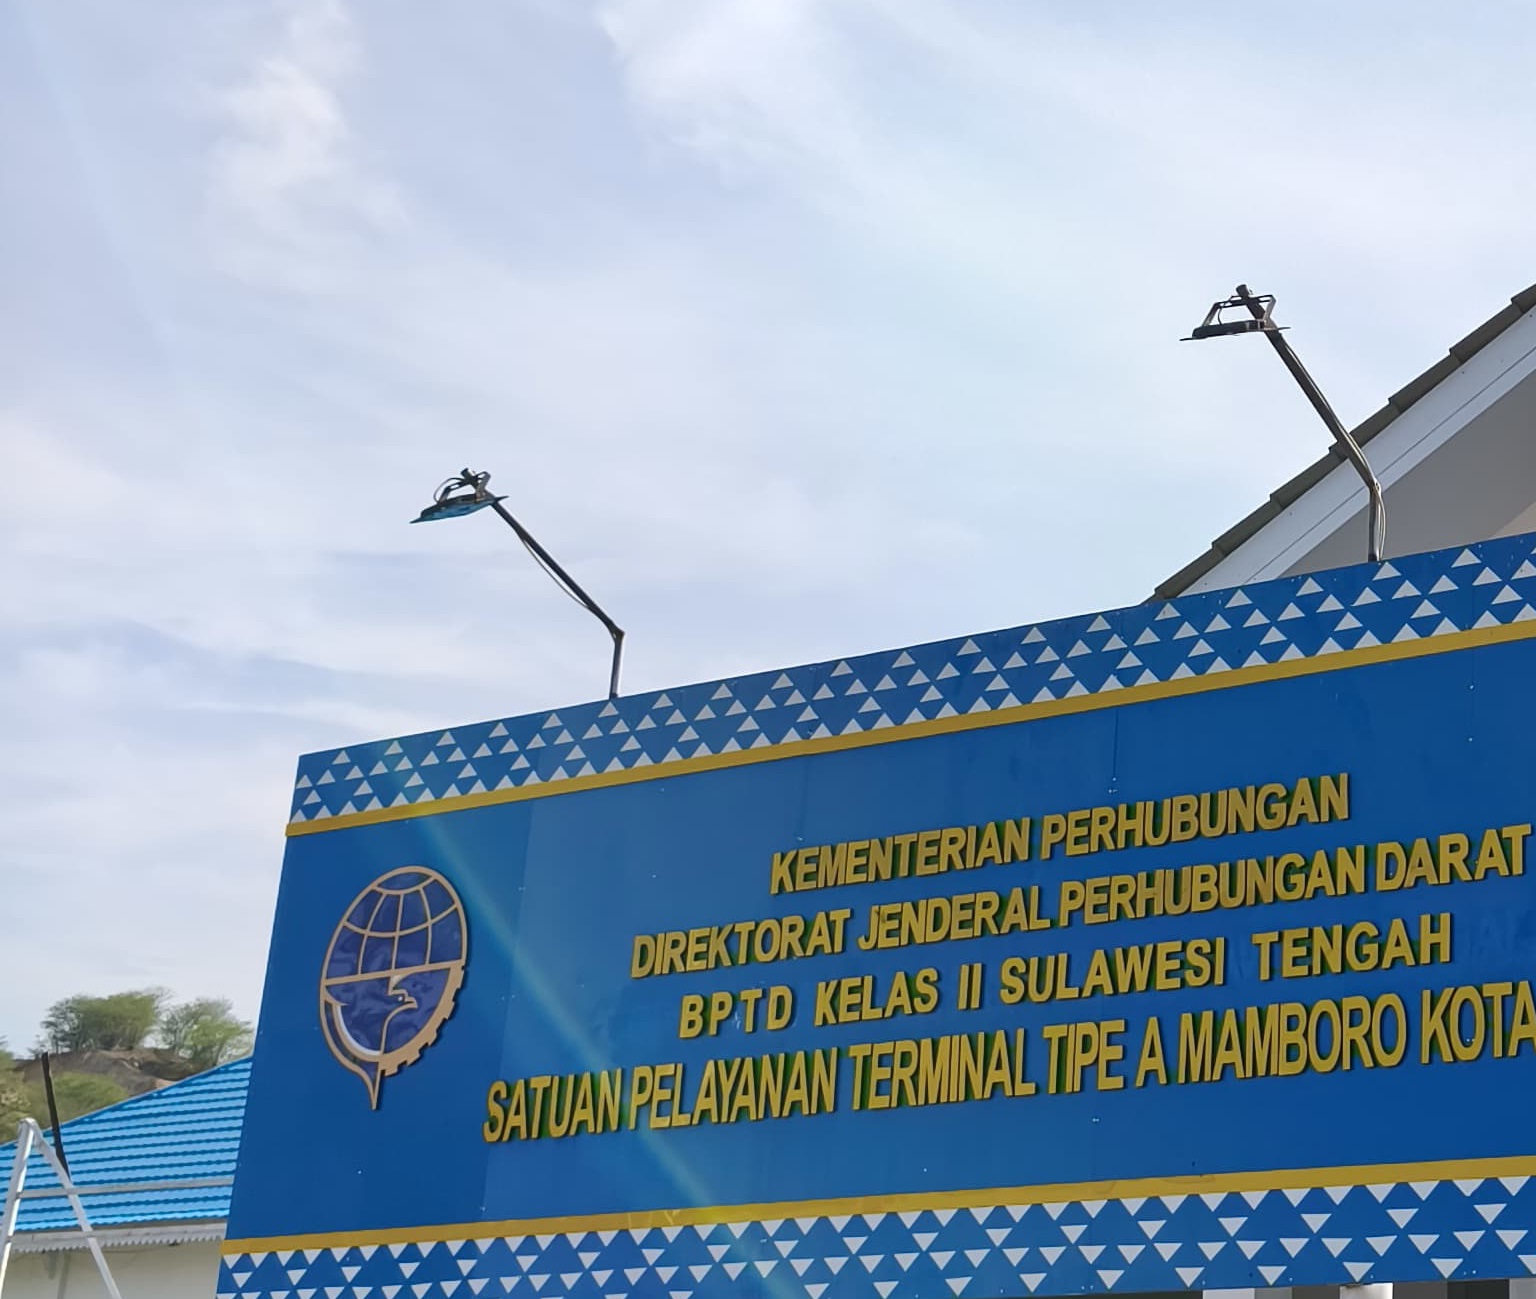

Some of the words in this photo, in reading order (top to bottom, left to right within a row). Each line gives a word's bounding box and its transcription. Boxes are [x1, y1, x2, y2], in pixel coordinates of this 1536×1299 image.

[631, 910, 850, 978] DIREKTORAT
[858, 887, 1051, 950] JENDERAL
[1057, 846, 1365, 927] PERHUBUNGAN
[1375, 825, 1530, 891] DARAT
[771, 819, 1031, 894] KEMENTERIAN
[1040, 775, 1347, 859] PERHUBUNGAN
[679, 986, 792, 1038] BPTD
[814, 969, 937, 1026] KELAS
[958, 964, 981, 1009] II
[1000, 938, 1224, 1004] SULAWESI
[1252, 914, 1450, 980] TENGAH
[483, 1070, 621, 1140] SATUAN
[628, 1049, 838, 1129] PELAYANAN
[847, 1030, 1036, 1110] TERMINAL
[1043, 1020, 1124, 1094] TIPE
[1136, 1018, 1167, 1086] A
[1177, 994, 1406, 1083] MAMBORO
